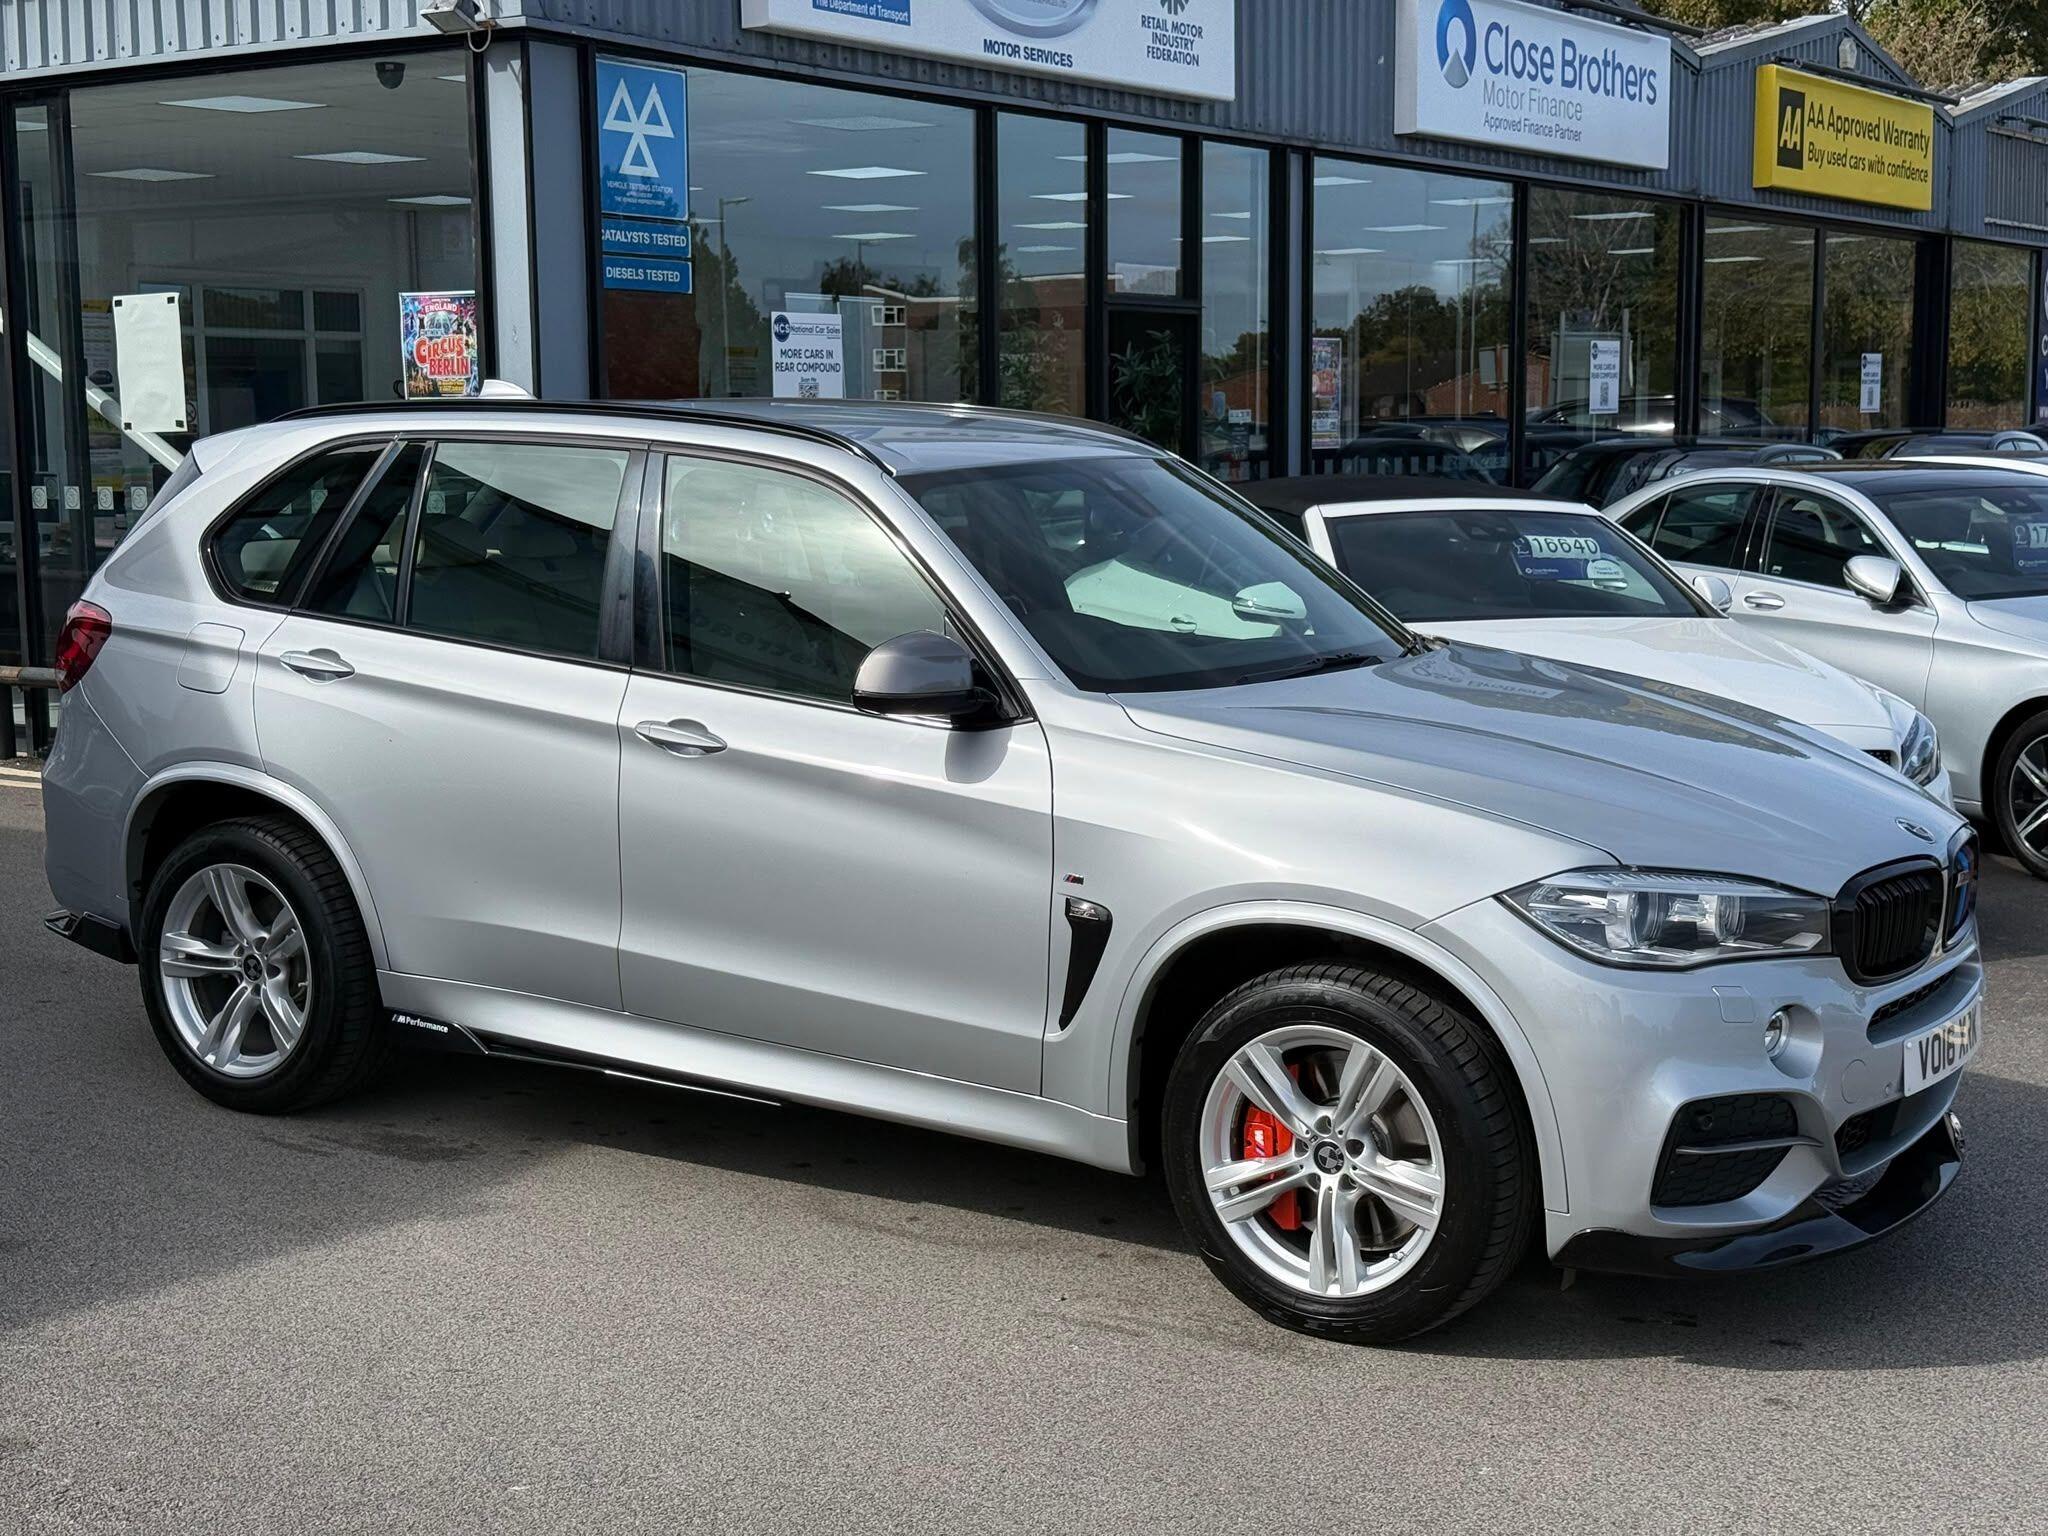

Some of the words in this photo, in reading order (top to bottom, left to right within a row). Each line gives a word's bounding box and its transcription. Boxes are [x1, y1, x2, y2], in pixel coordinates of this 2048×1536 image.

[830, 0, 868, 15] Department
[869, 5, 876, 16] of
[877, 6, 908, 22] Transport
[1141, 14, 1169, 32] RETAIL
[1171, 20, 1203, 39] MOTOR
[1152, 31, 1195, 51] INDUSTRY
[983, 38, 1021, 59] MOTOR
[1023, 46, 1073, 68] SERVICES
[1146, 45, 1200, 67] FEDERATION
[1484, 21, 1555, 85] Close
[1561, 38, 1657, 105] Brothers
[1483, 79, 1525, 110] Motor
[1528, 88, 1583, 121] Finance
[1483, 112, 1522, 133] Approved
[1523, 118, 1553, 138] Finance
[1554, 124, 1582, 142] Partner
[1780, 105, 1801, 151] AA
[1807, 101, 1825, 130] AA
[1826, 106, 1881, 142] Approved
[1882, 118, 1930, 158] Warranty
[1807, 142, 1825, 169] Buy
[1827, 148, 1847, 168] used
[1849, 154, 1866, 171] cars
[1867, 154, 1885, 174] with
[1886, 159, 1929, 183] confidence
[651, 233, 687, 247] TESTED
[605, 266, 644, 280] DIESELS
[645, 269, 680, 282] TESTED
[424, 302, 458, 313] ENGLAND
[791, 324, 814, 334] National
[815, 325, 826, 334] Car
[826, 326, 840, 335] Sales
[415, 337, 464, 363] CIRCUS
[780, 348, 803, 359] MORE
[803, 348, 825, 359] CARS
[826, 349, 834, 359] IN
[429, 358, 469, 376] BERLIN
[775, 362, 795, 372] REAR
[796, 362, 841, 373] COMPOUND
